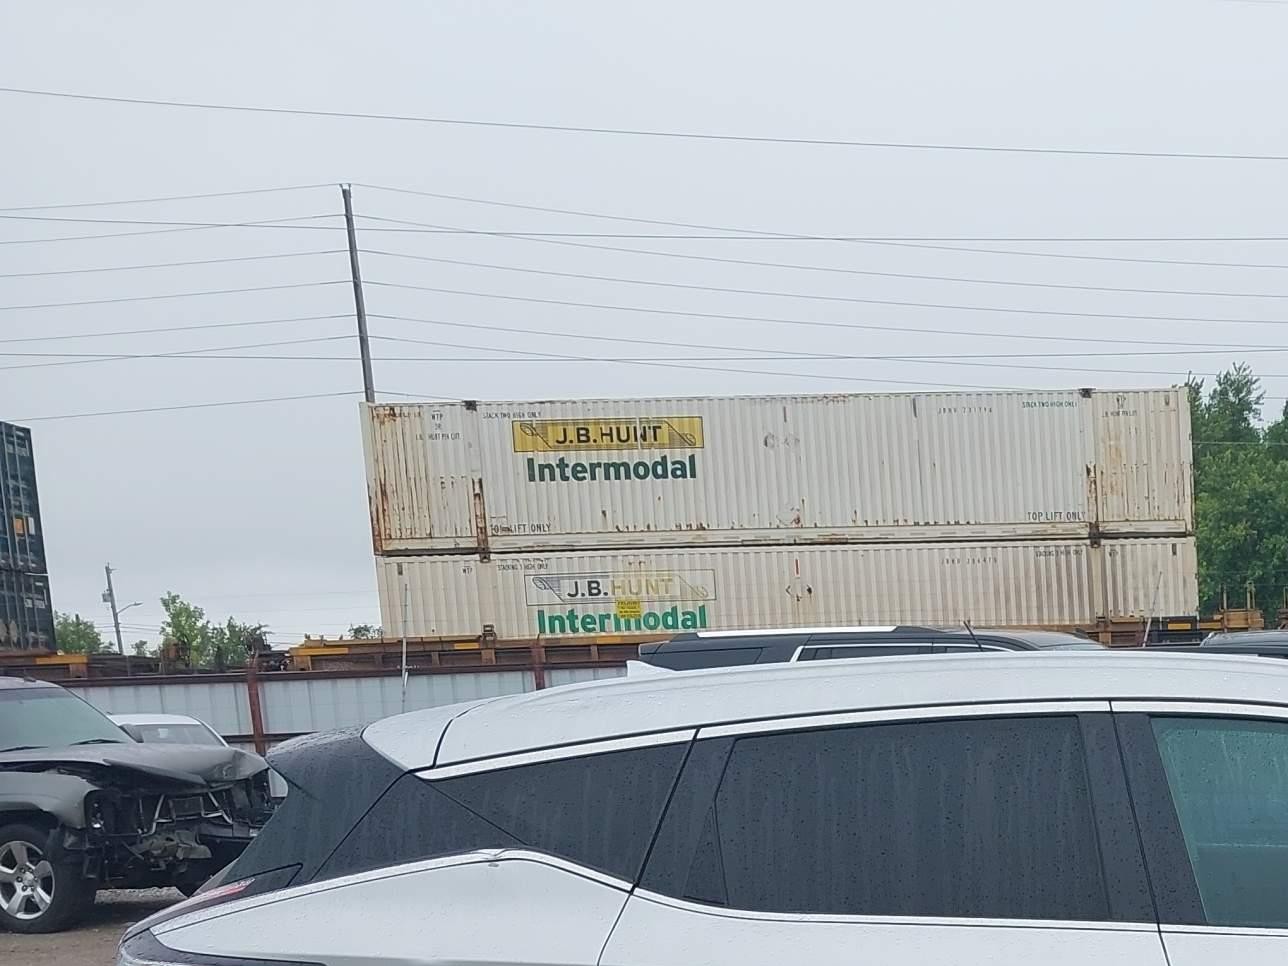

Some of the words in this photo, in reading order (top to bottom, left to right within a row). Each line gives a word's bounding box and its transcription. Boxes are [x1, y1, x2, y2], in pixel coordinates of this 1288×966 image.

[526, 454, 697, 482] Intermodal
[1027, 511, 1043, 522] TOP
[1045, 511, 1062, 521] LIFT
[1066, 511, 1086, 521] ONLY
[530, 522, 551, 533] ONLY
[537, 604, 707, 634] Intermodal
